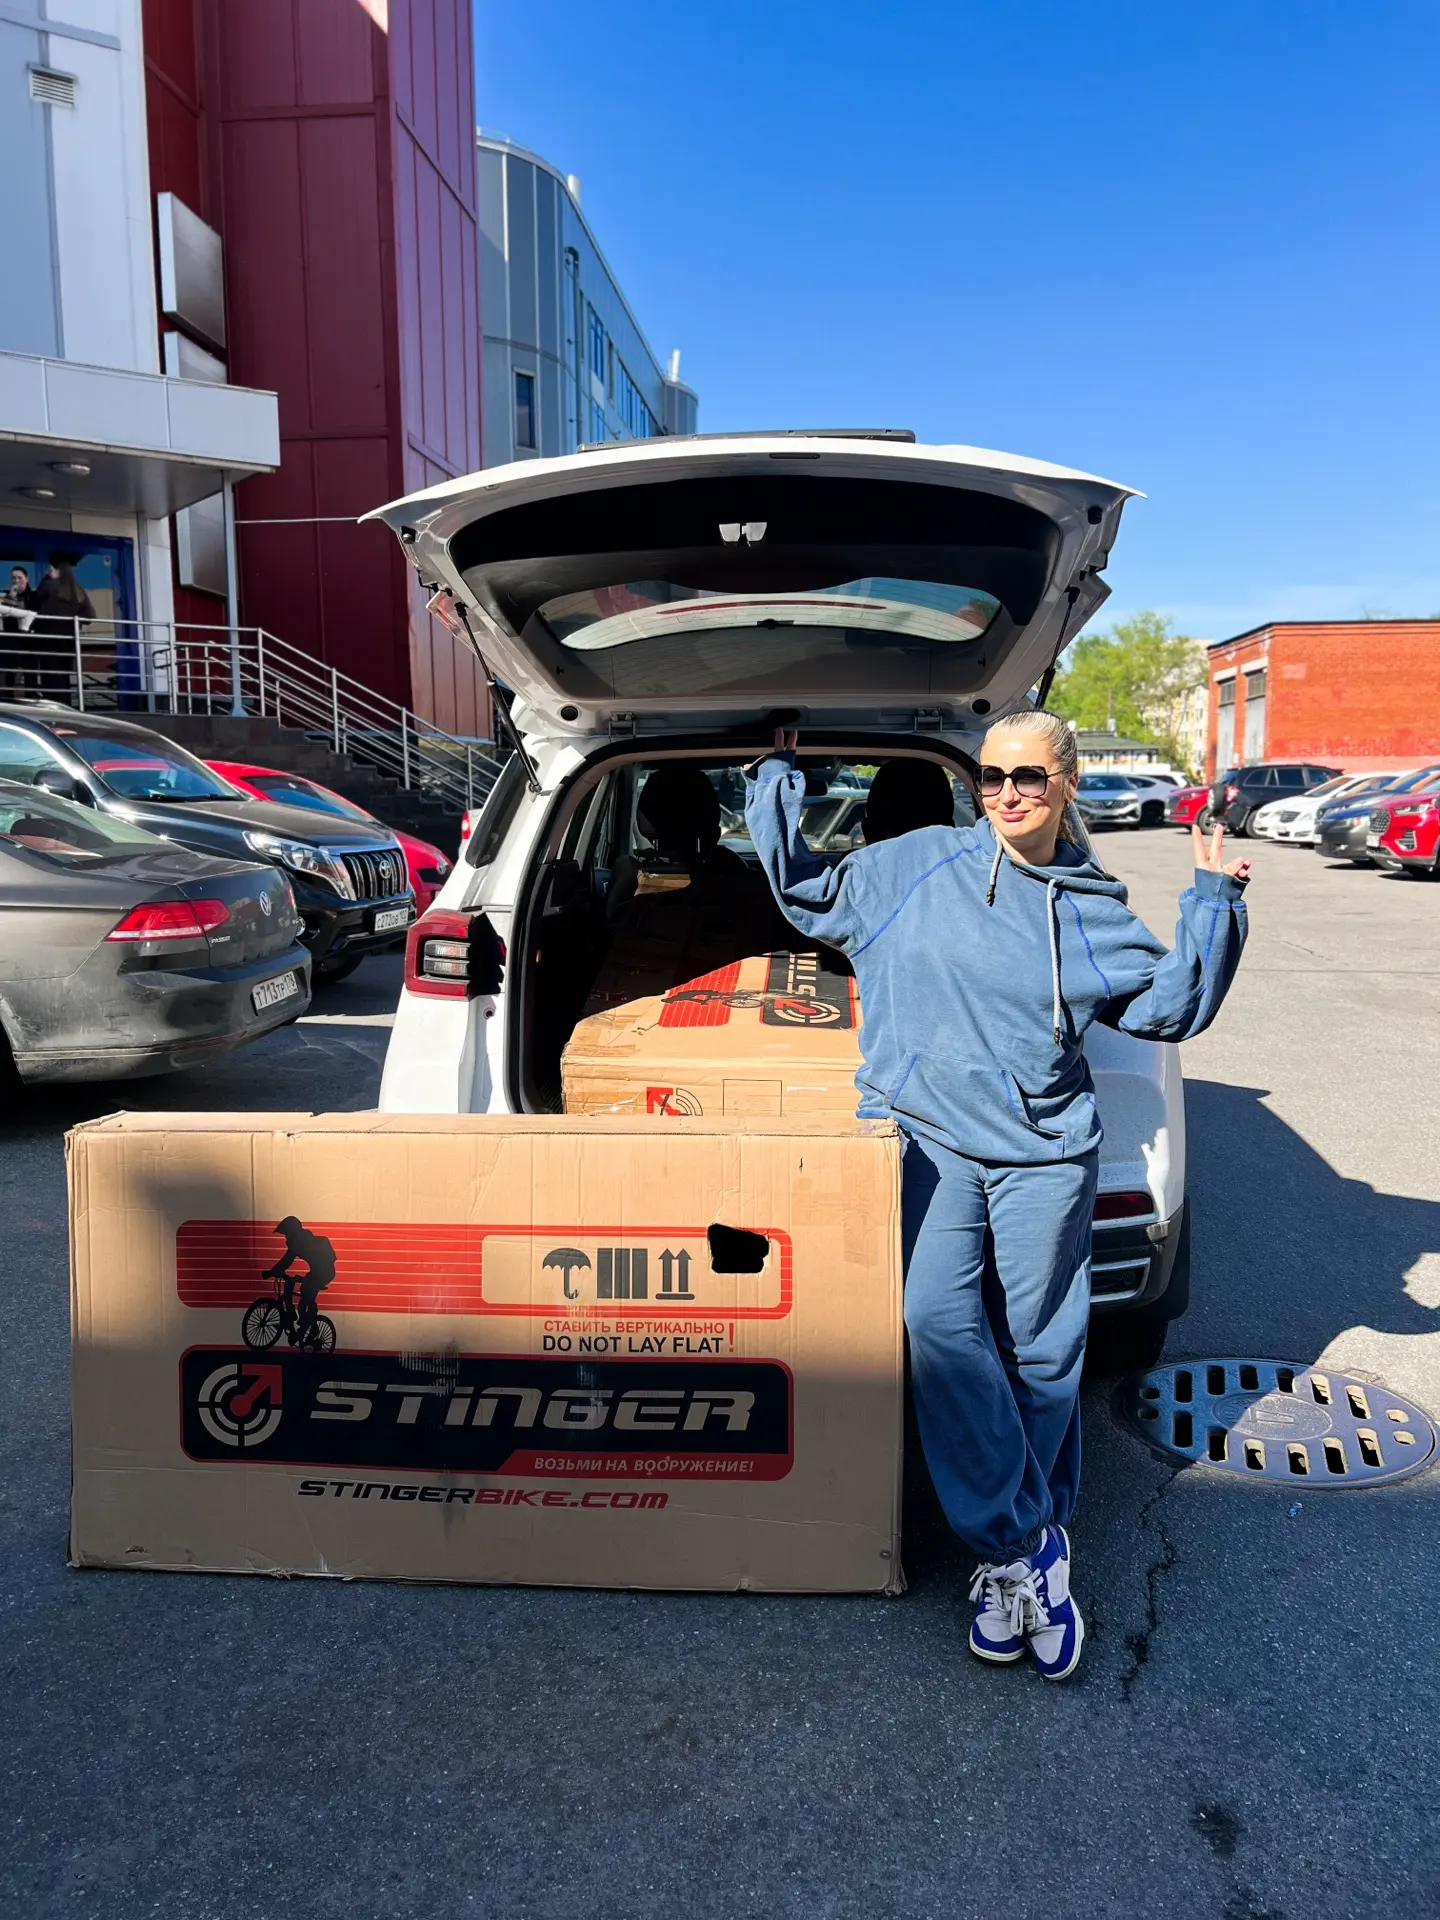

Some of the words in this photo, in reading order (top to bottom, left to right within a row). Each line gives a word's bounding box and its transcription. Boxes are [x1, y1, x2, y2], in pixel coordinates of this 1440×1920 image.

[543, 1320, 611, 1333] СТАВИТЬ
[543, 1335, 572, 1352] DO
[578, 1335, 621, 1353] NOT
[628, 1336, 667, 1353] LAY
[672, 1337, 724, 1354] FLAT
[309, 1380, 756, 1432] STINGER
[534, 1457, 602, 1471] ВОЗЬМИ
[605, 1458, 628, 1471] НА
[634, 1457, 755, 1475] ВООРУЖЕНИЕ!
